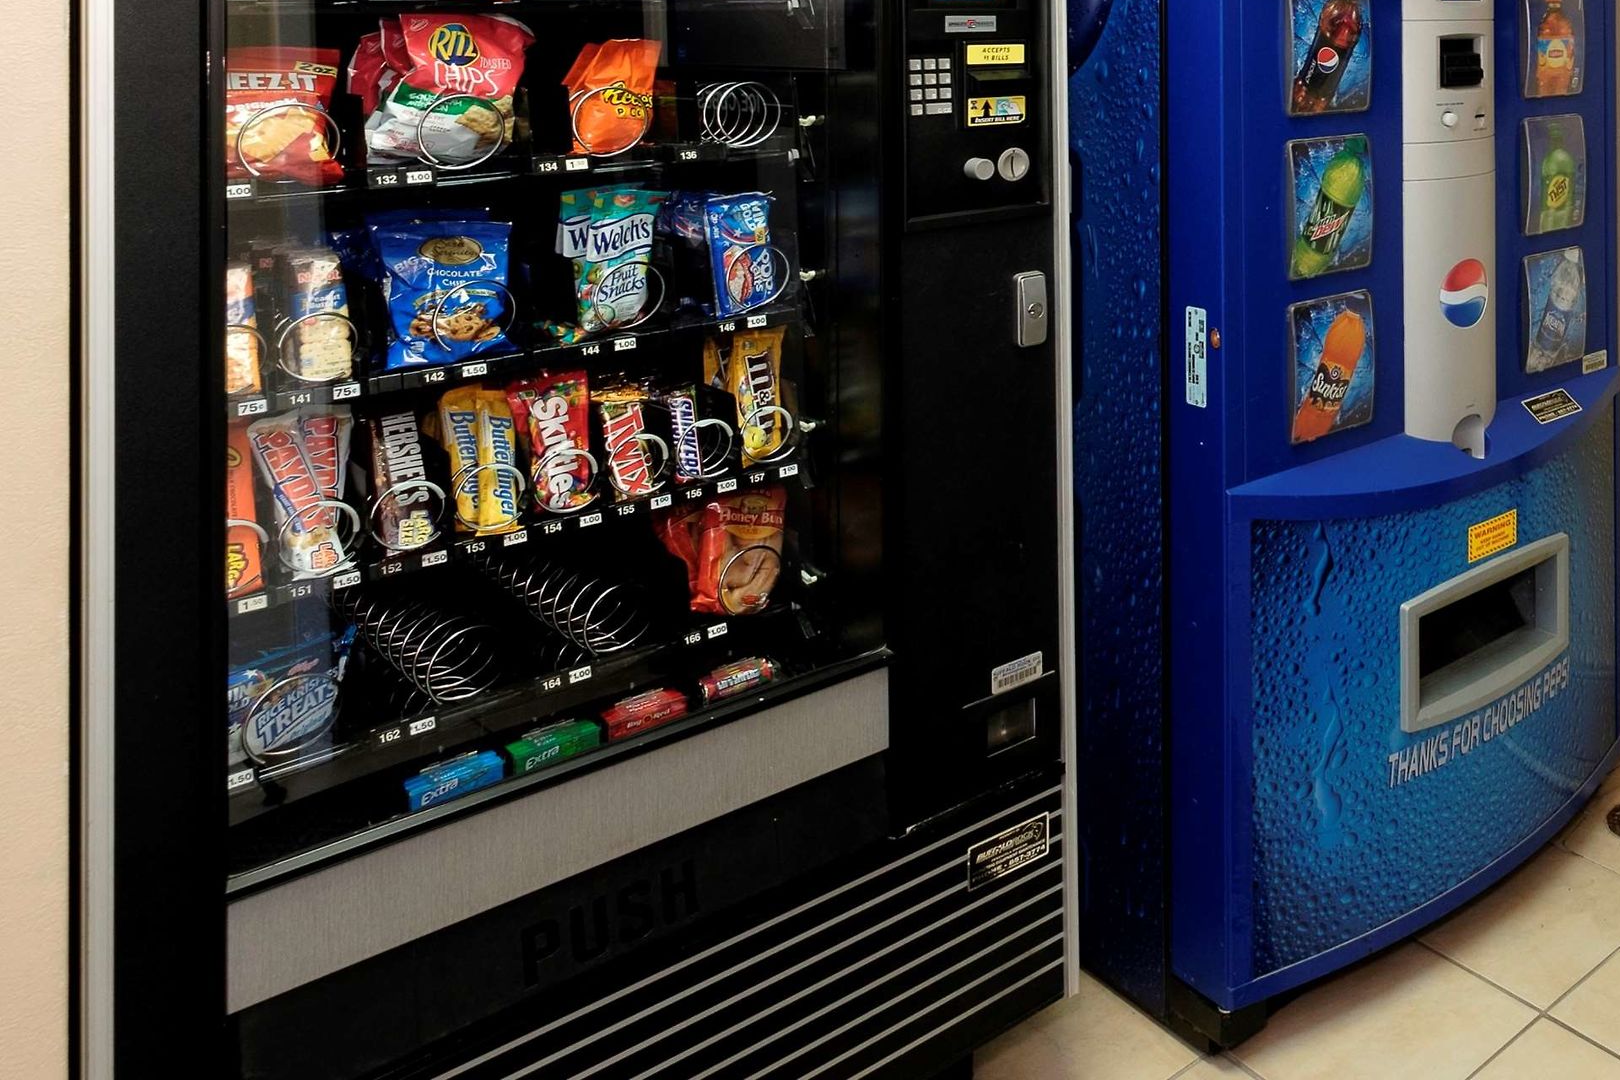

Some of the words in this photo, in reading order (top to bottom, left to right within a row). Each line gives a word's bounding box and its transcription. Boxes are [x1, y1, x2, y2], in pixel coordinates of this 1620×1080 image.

[430, 26, 478, 62] RITZ
[982, 46, 1011, 54] ACCEPTS
[991, 54, 1009, 62] BILLS
[226, 72, 317, 91] EEZ-IT
[434, 60, 500, 97] CHIPS
[680, 151, 697, 160] 136
[539, 162, 558, 171] 134
[376, 175, 397, 185] 132
[594, 221, 650, 256] Welch's
[611, 264, 639, 286] Fruit
[600, 276, 646, 302] Snacks
[719, 323, 736, 332] 146
[582, 345, 599, 355] 144
[424, 372, 445, 382] 142
[1312, 372, 1347, 399] Sunkist
[289, 393, 311, 404] 141
[532, 396, 579, 510] Skittles
[604, 402, 652, 494] TWIX
[381, 410, 429, 507] HERSHE'S
[254, 430, 334, 533] PAYDAY
[749, 473, 765, 483] 157
[686, 488, 702, 499] 156
[617, 505, 635, 515] 155
[719, 506, 758, 527] Honey
[761, 511, 783, 524] Bun
[411, 510, 434, 544] LARG
[544, 523, 562, 533] 154
[1474, 520, 1511, 539] WARNING
[466, 542, 486, 553] 153
[226, 544, 249, 588] LARG
[381, 563, 402, 574] 152
[290, 585, 312, 597] 151
[684, 633, 701, 644] 166
[543, 677, 561, 689] 164
[256, 699, 286, 732] RICE
[262, 681, 338, 749] TREATS
[379, 730, 401, 743] 162
[1388, 731, 1448, 788] THANKS
[1452, 719, 1479, 758] FOR
[1484, 684, 1540, 742] CHOOSING
[525, 742, 560, 770] Extra
[421, 778, 459, 806] Extra
[520, 858, 700, 993] PUSH
